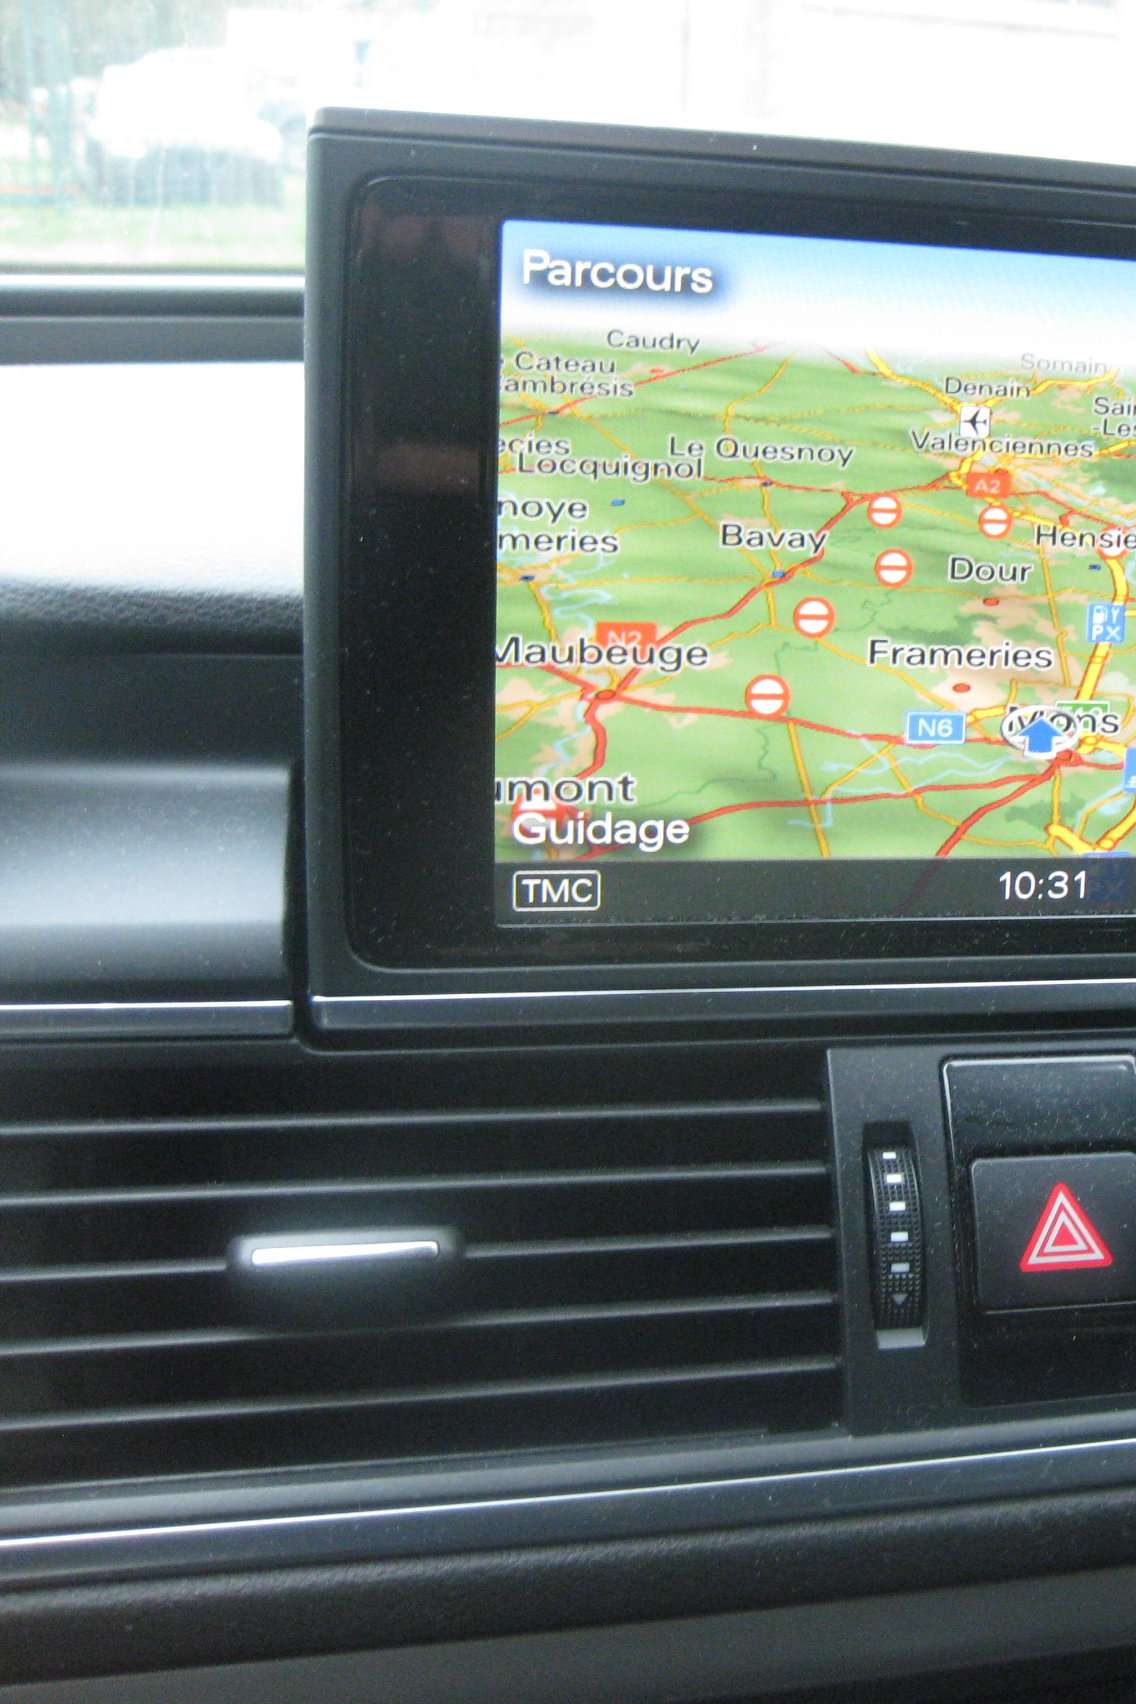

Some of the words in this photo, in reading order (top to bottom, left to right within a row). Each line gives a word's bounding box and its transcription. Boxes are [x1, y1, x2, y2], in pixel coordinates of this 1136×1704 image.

[522, 248, 713, 294] Parcours
[607, 329, 700, 354] Caudry
[515, 351, 616, 373] Cateau
[1020, 353, 1107, 375] Somain
[498, 375, 634, 397] ambrésis
[944, 376, 1031, 399] Denain
[670, 436, 705, 458] Le
[716, 437, 854, 466] Quesnoy
[912, 430, 1094, 458] Valenciennes
[517, 452, 704, 484] Locquignol
[973, 475, 1001, 494] A2
[498, 527, 619, 553] meries
[721, 523, 828, 552] Bavay
[949, 557, 1032, 582] Dour
[868, 639, 1053, 669] Frameries
[917, 719, 953, 737] N6
[512, 811, 690, 852] Guidage
[521, 878, 593, 903] TMC
[998, 870, 1088, 900] 10:31
